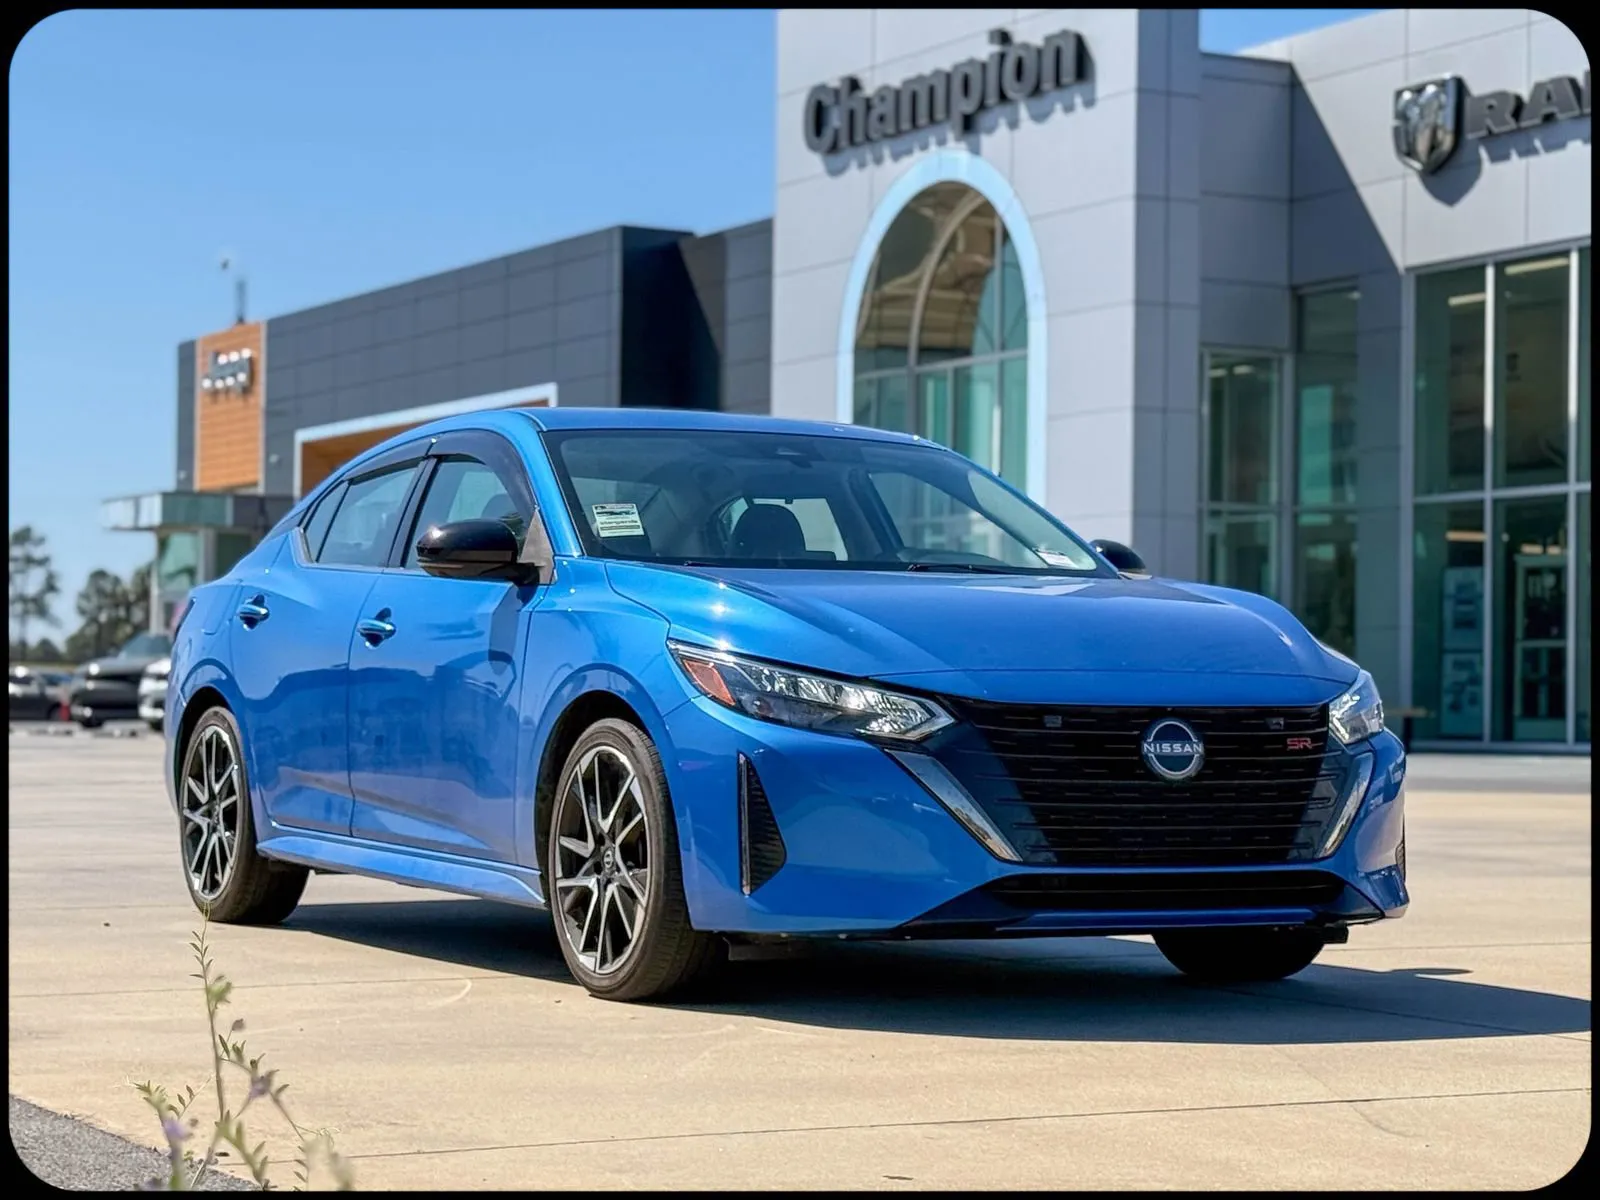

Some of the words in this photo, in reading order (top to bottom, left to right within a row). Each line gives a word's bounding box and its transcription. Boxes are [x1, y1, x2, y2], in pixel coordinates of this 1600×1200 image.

[804, 28, 1092, 154] Champion
[1464, 71, 1591, 139] RA
[1143, 742, 1203, 754] NISSAN
[1287, 737, 1312, 750] SR
